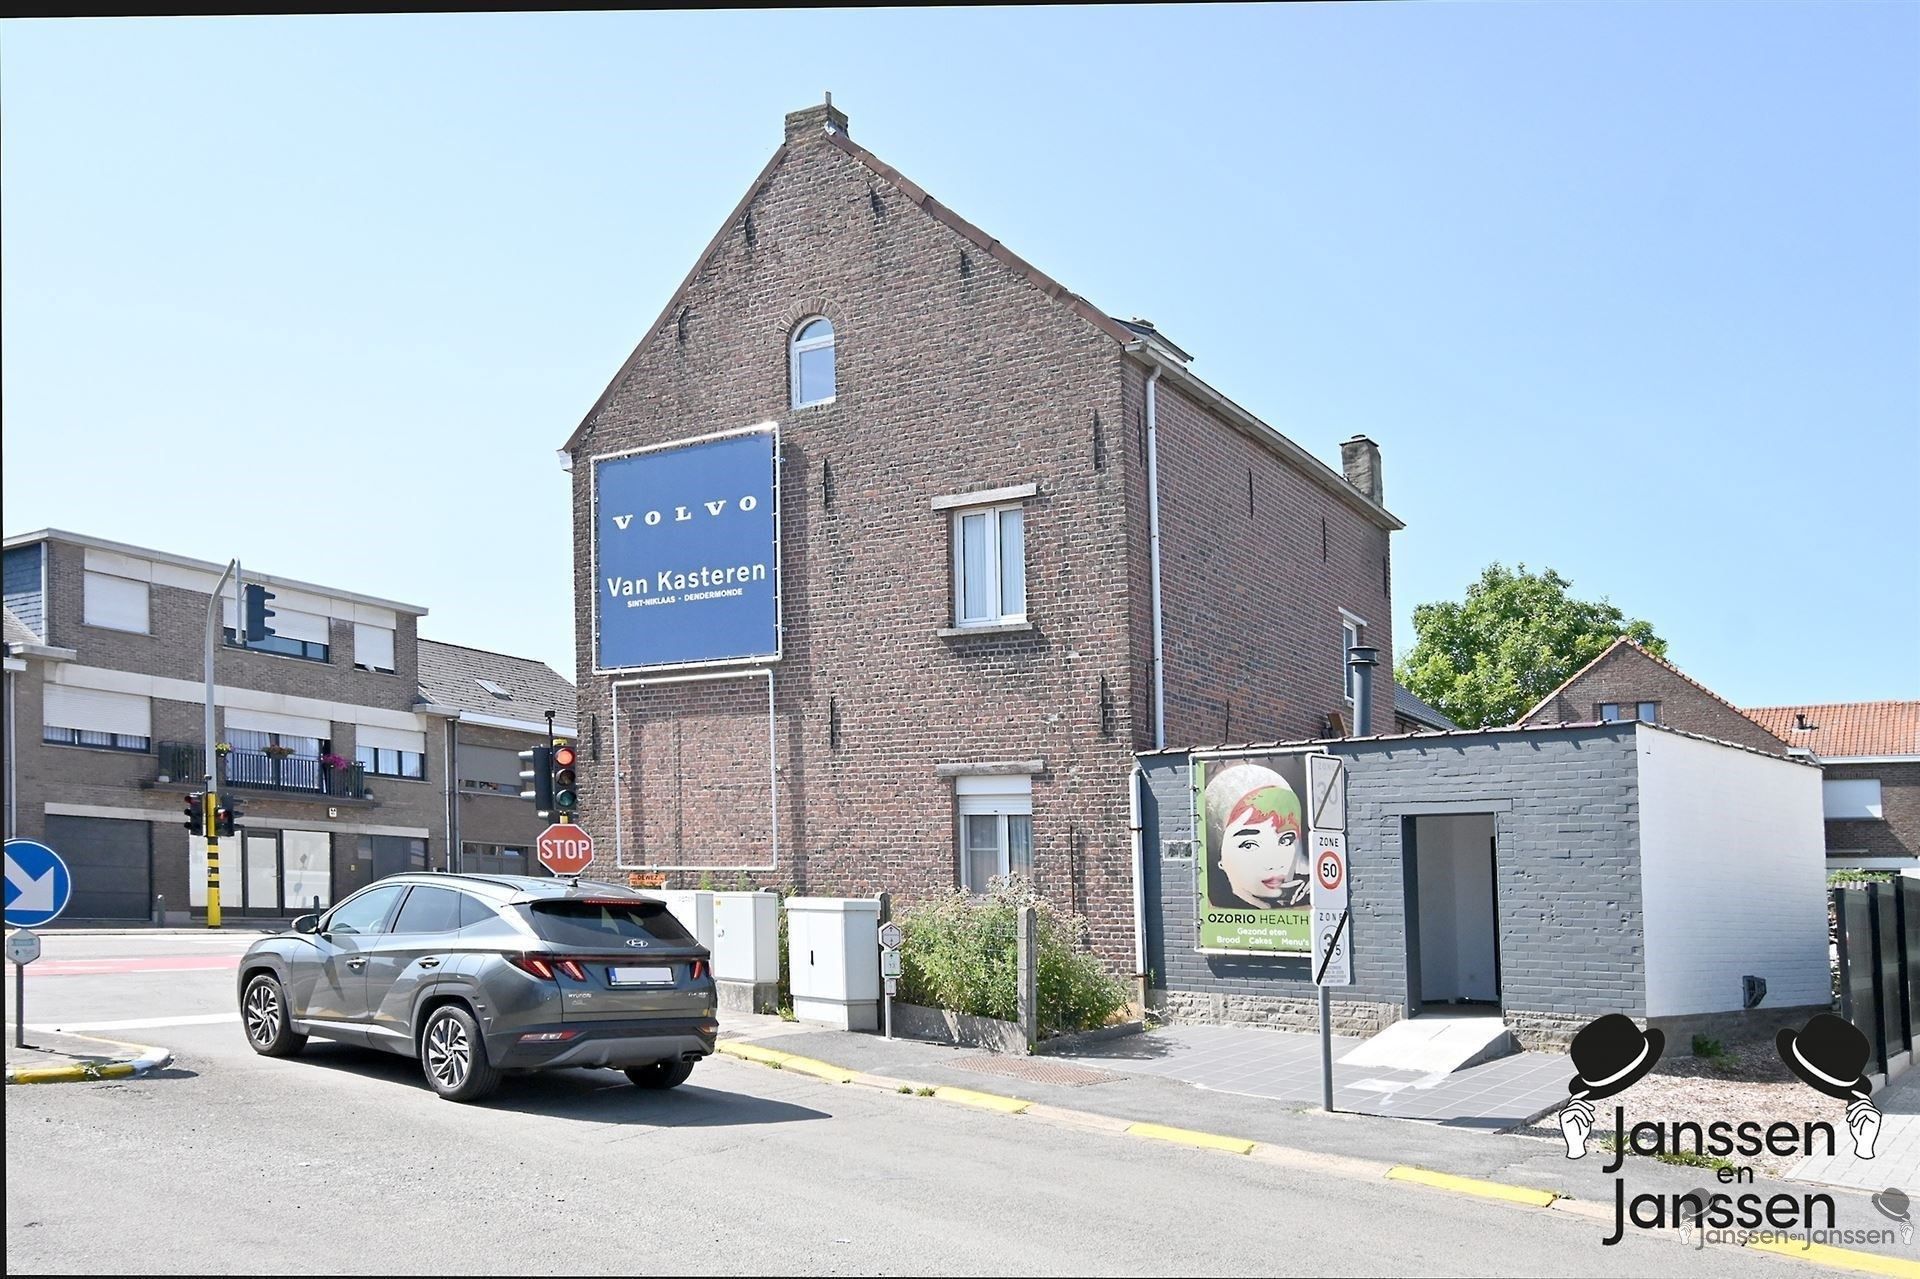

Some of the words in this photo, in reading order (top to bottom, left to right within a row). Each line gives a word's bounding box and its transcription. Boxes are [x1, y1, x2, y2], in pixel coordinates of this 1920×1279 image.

[612, 496, 757, 530] VOLVO
[607, 577, 648, 597] Van
[657, 563, 766, 592] Kasteren
[684, 588, 743, 602] DENDERMONDE
[541, 839, 590, 859] STOP
[1319, 837, 1339, 847] ZONE
[1323, 863, 1337, 878] 50
[1208, 913, 1256, 924] OZORIO
[1237, 928, 1267, 936] Gezond
[1269, 928, 1287, 936] eten
[1216, 936, 1241, 944] Brood
[1248, 937, 1273, 945] Cakes
